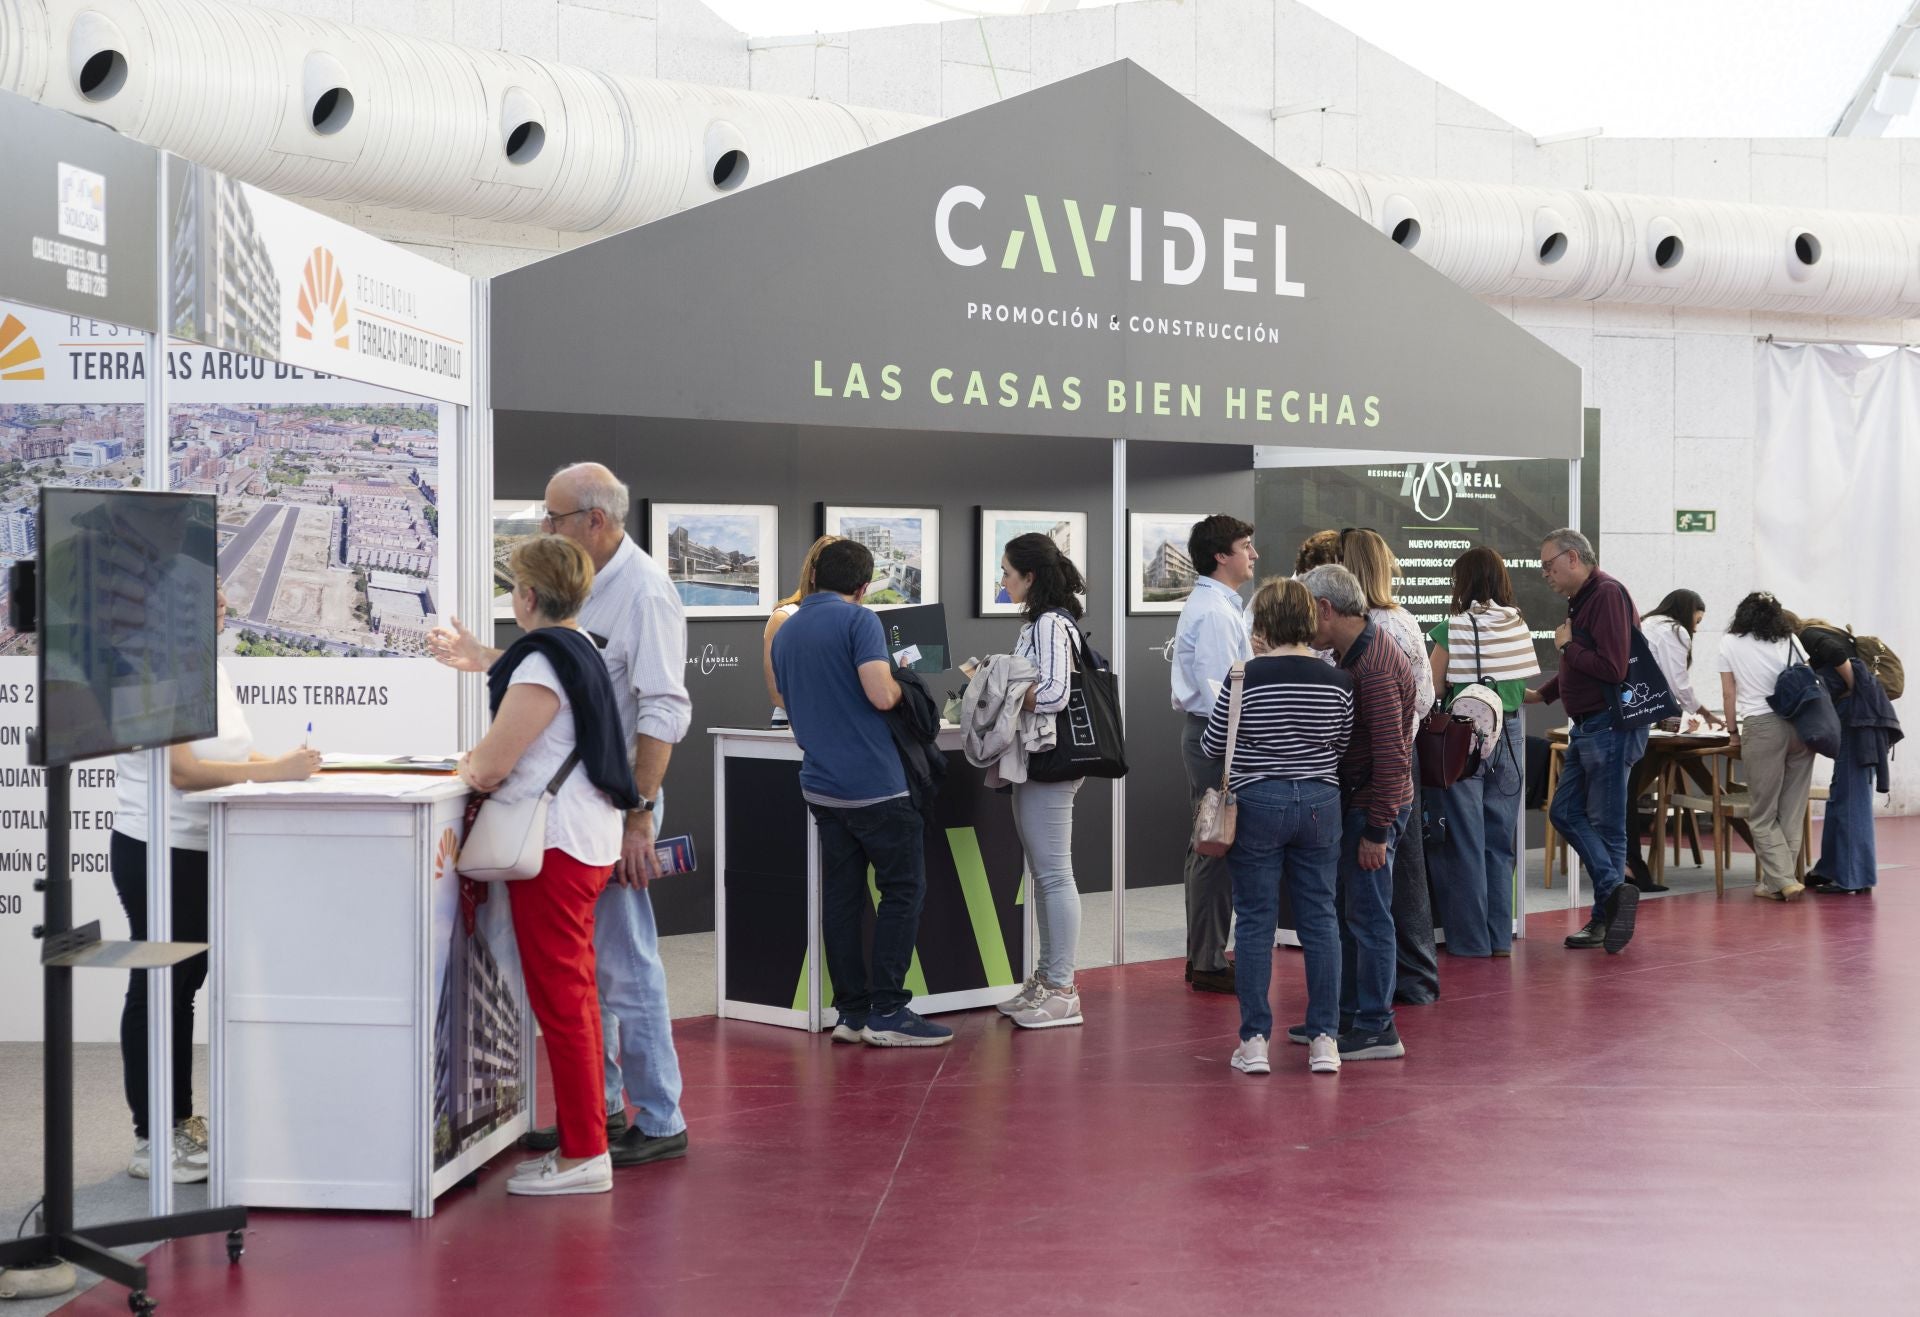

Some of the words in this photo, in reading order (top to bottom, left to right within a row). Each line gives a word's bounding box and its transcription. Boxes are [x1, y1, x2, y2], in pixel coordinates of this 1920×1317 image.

[935, 185, 1305, 297] CAVIDEL
[357, 273, 418, 319] RESIDENCIAL
[967, 302, 1098, 329] PROMOCIÓN
[1109, 314, 1120, 331] &
[1129, 316, 1280, 343] CONSTRUCCIÓN
[357, 319, 397, 362] TERRAZAS
[398, 332, 417, 368] ARCO
[419, 338, 428, 371] DE
[430, 342, 461, 379] LADRILLO
[69, 351, 192, 380] TERRAAS
[814, 360, 902, 401] LAS
[930, 368, 1082, 411] CASAS
[1107, 380, 1201, 418] BIEN
[1225, 386, 1382, 428] HECHAS
[1367, 469, 1413, 478] RESIDENCIAL
[1408, 540, 1433, 549] NUEVO
[1434, 540, 1471, 549] PROYECTO
[1395, 558, 1442, 568] DORMITORIOS
[1407, 577, 1417, 586] DE
[25, 684, 34, 703] 2
[303, 685, 388, 705] TERRAZAS
[78, 769, 118, 788] REFR
